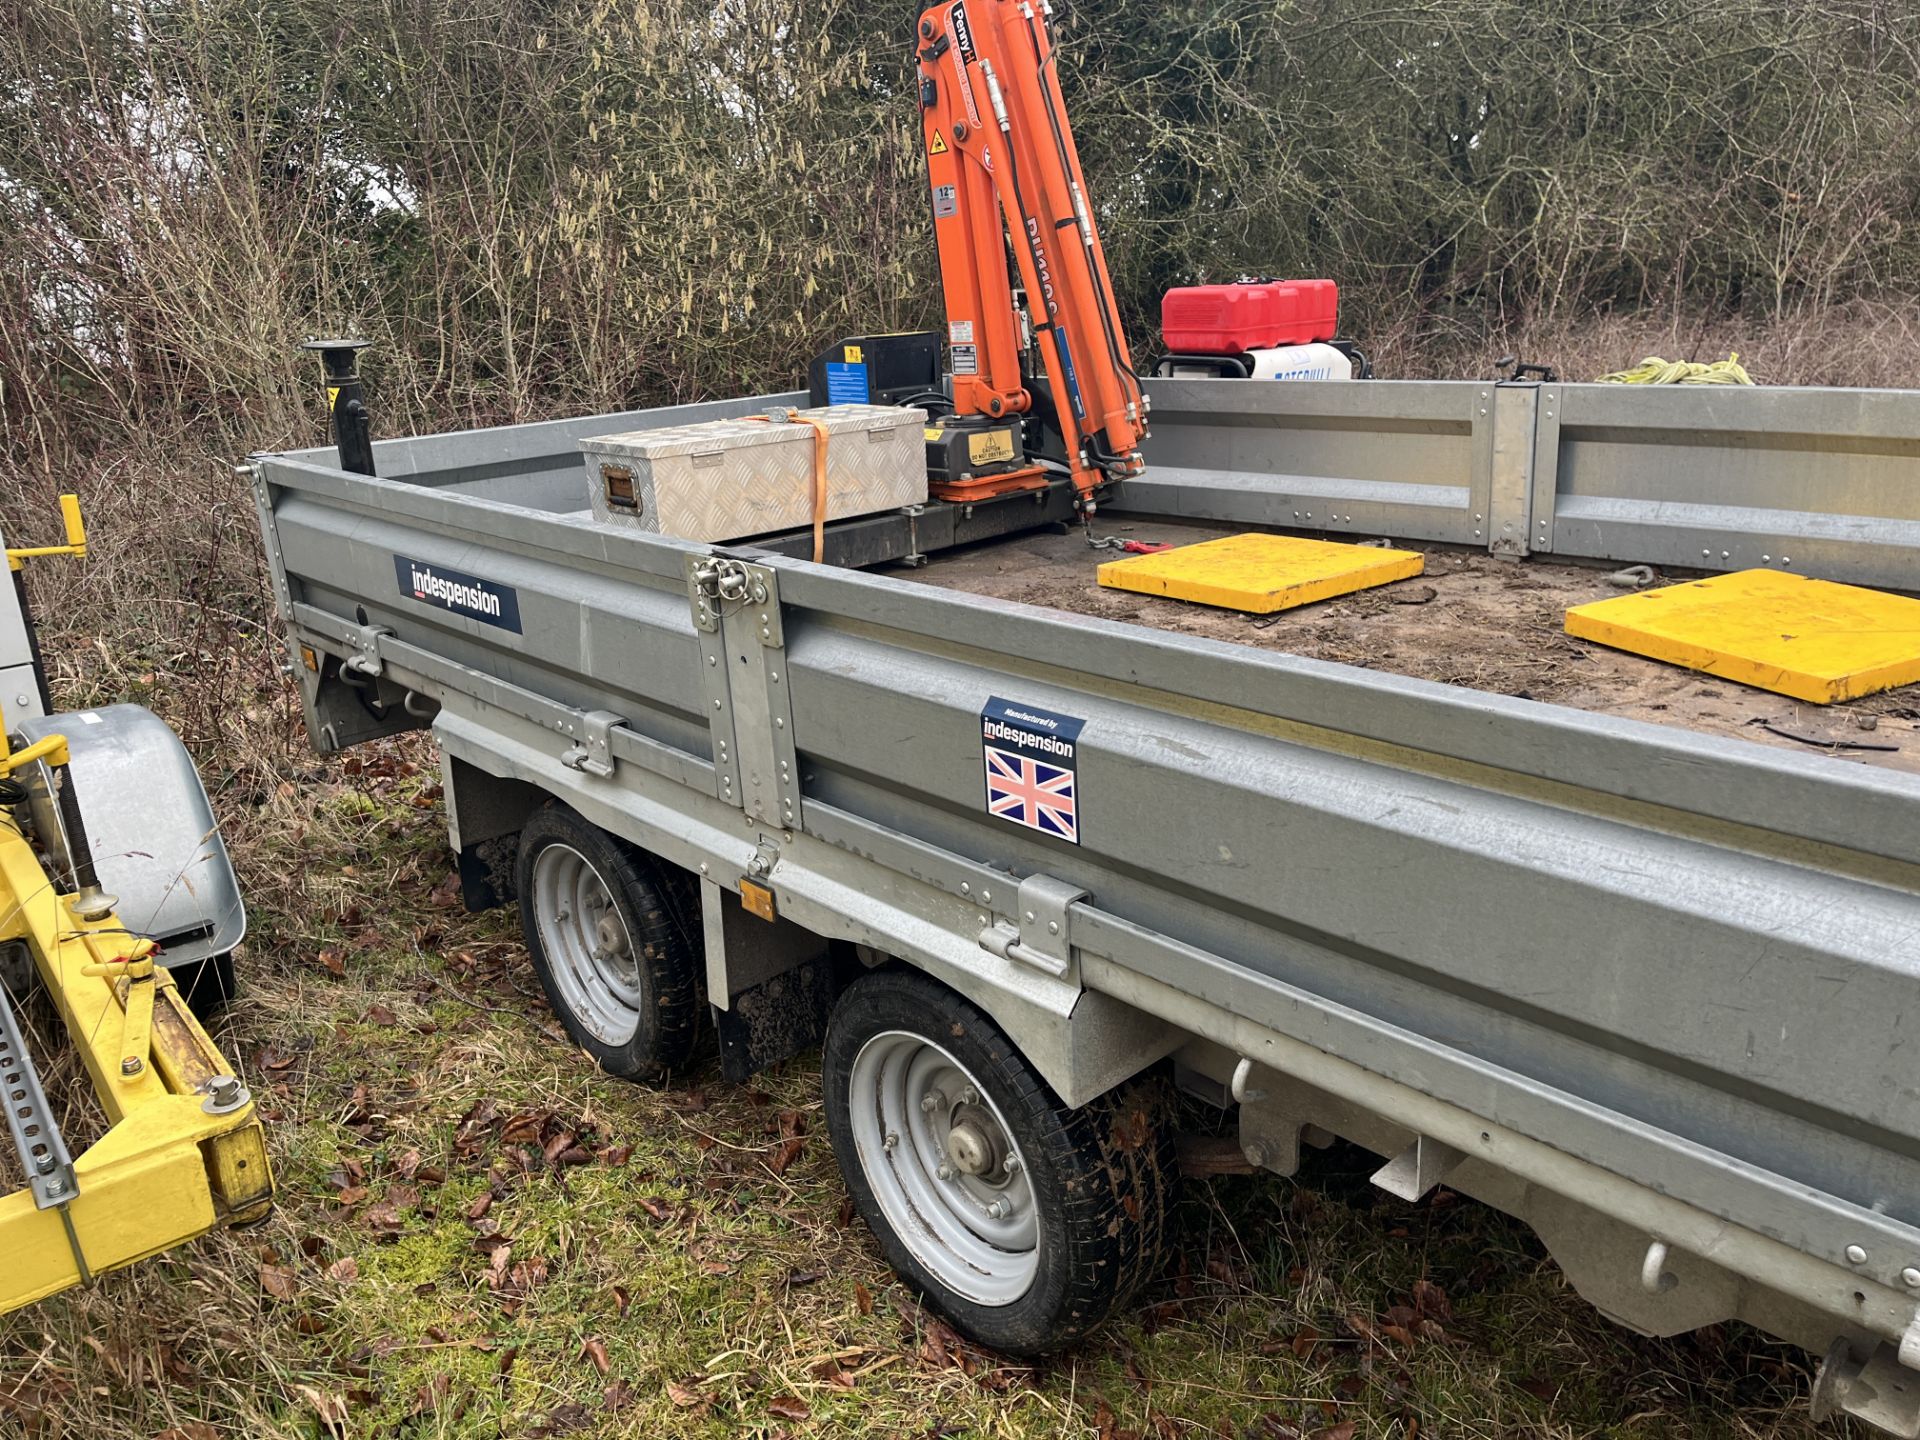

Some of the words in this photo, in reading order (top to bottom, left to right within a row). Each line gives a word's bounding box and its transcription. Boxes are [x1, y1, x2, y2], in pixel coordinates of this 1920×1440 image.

[411, 563, 500, 616] indespension
[984, 717, 1073, 758] indespension
[1004, 708, 1049, 725] Manufactured
[1049, 720, 1058, 729] by
